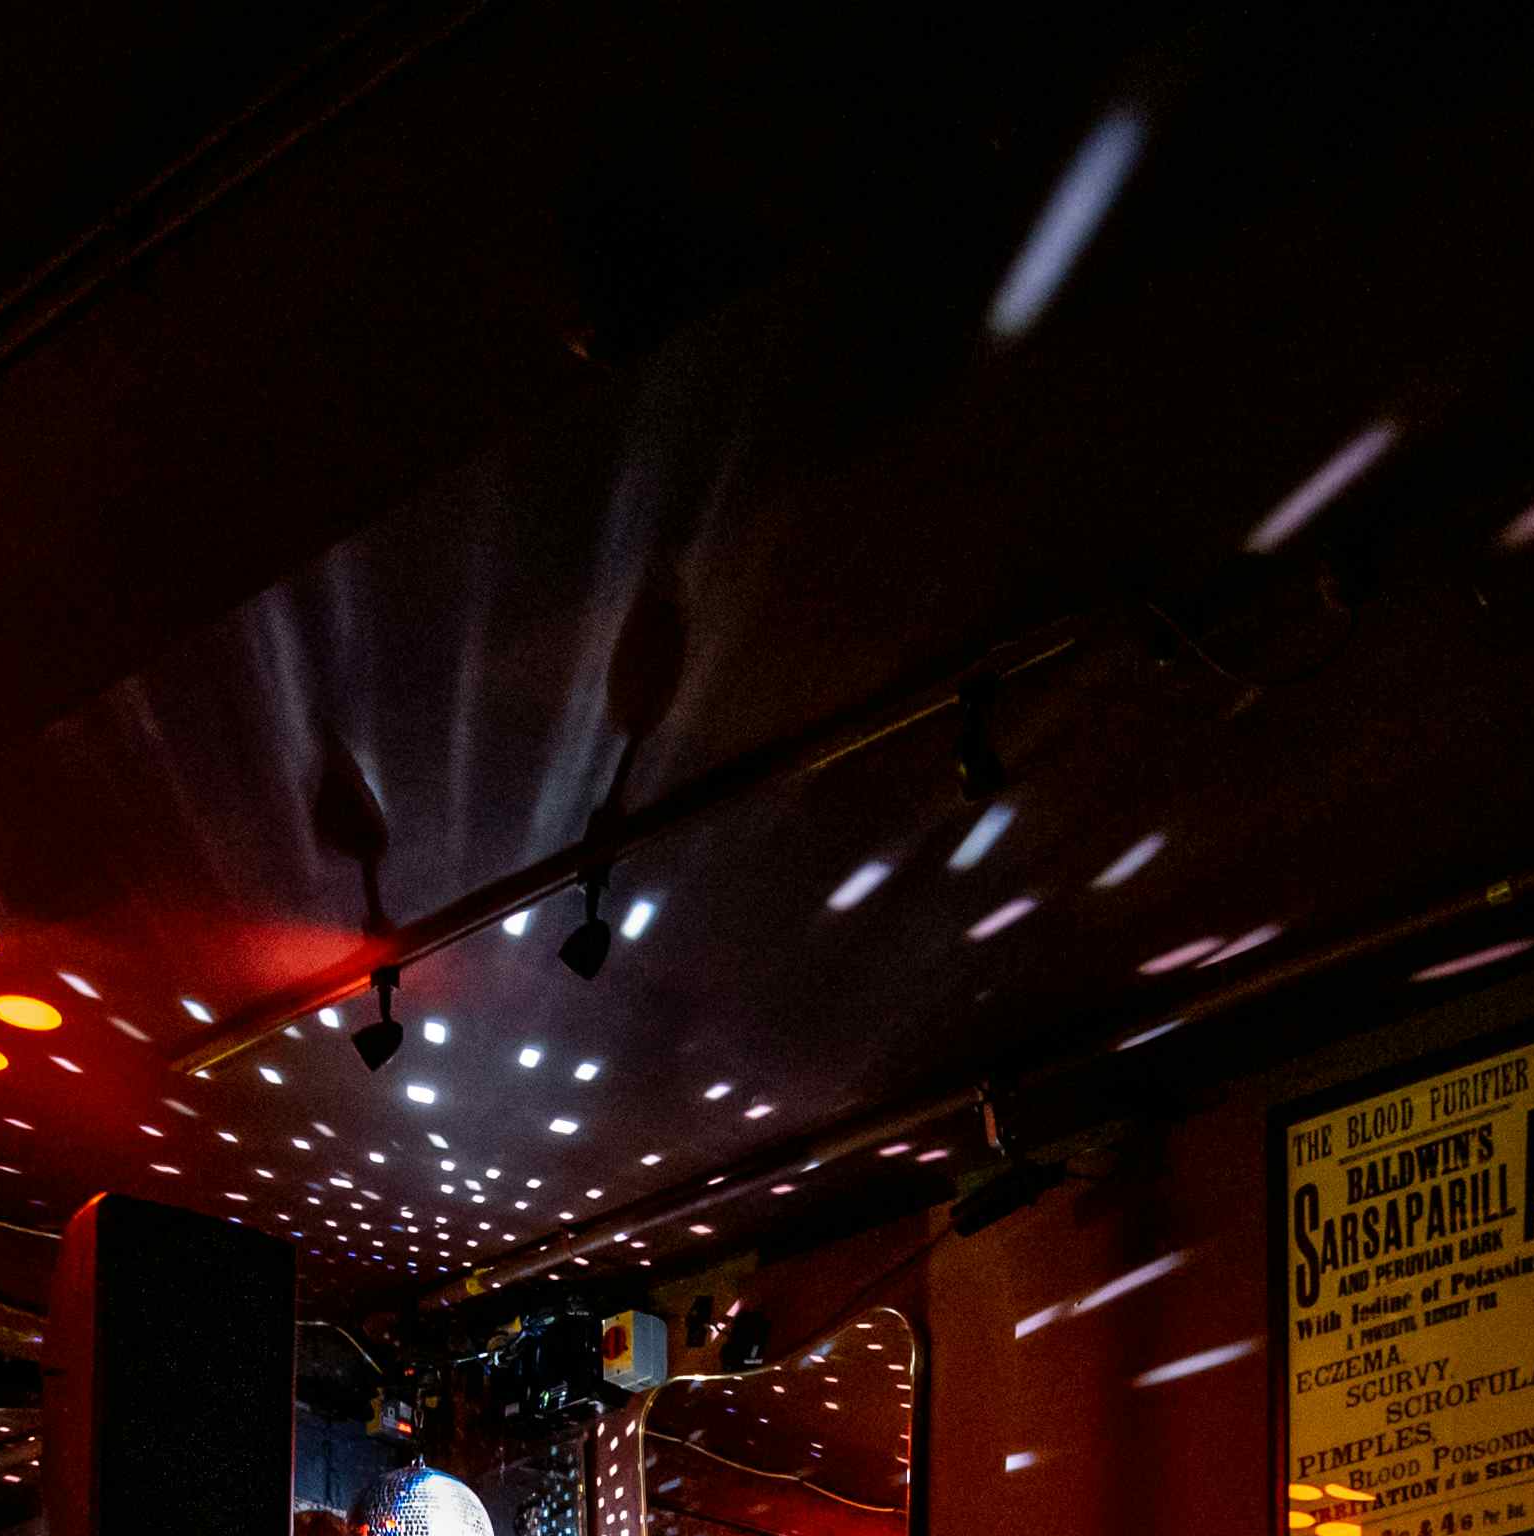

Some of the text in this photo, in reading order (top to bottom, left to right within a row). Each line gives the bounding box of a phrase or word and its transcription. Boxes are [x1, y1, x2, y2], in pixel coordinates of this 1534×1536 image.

[1293, 1058, 1529, 1167] THE BLOOD PURIFIER
[1347, 1121, 1495, 1206] BALDWIN'S
[1338, 1228, 1505, 1298] AND PERUVIAN BARK
[1297, 1309, 1342, 1341] With
[1350, 1292, 1413, 1326] Iodine
[1420, 1279, 1441, 1304] of
[1349, 1458, 1421, 1491] BLOOD
